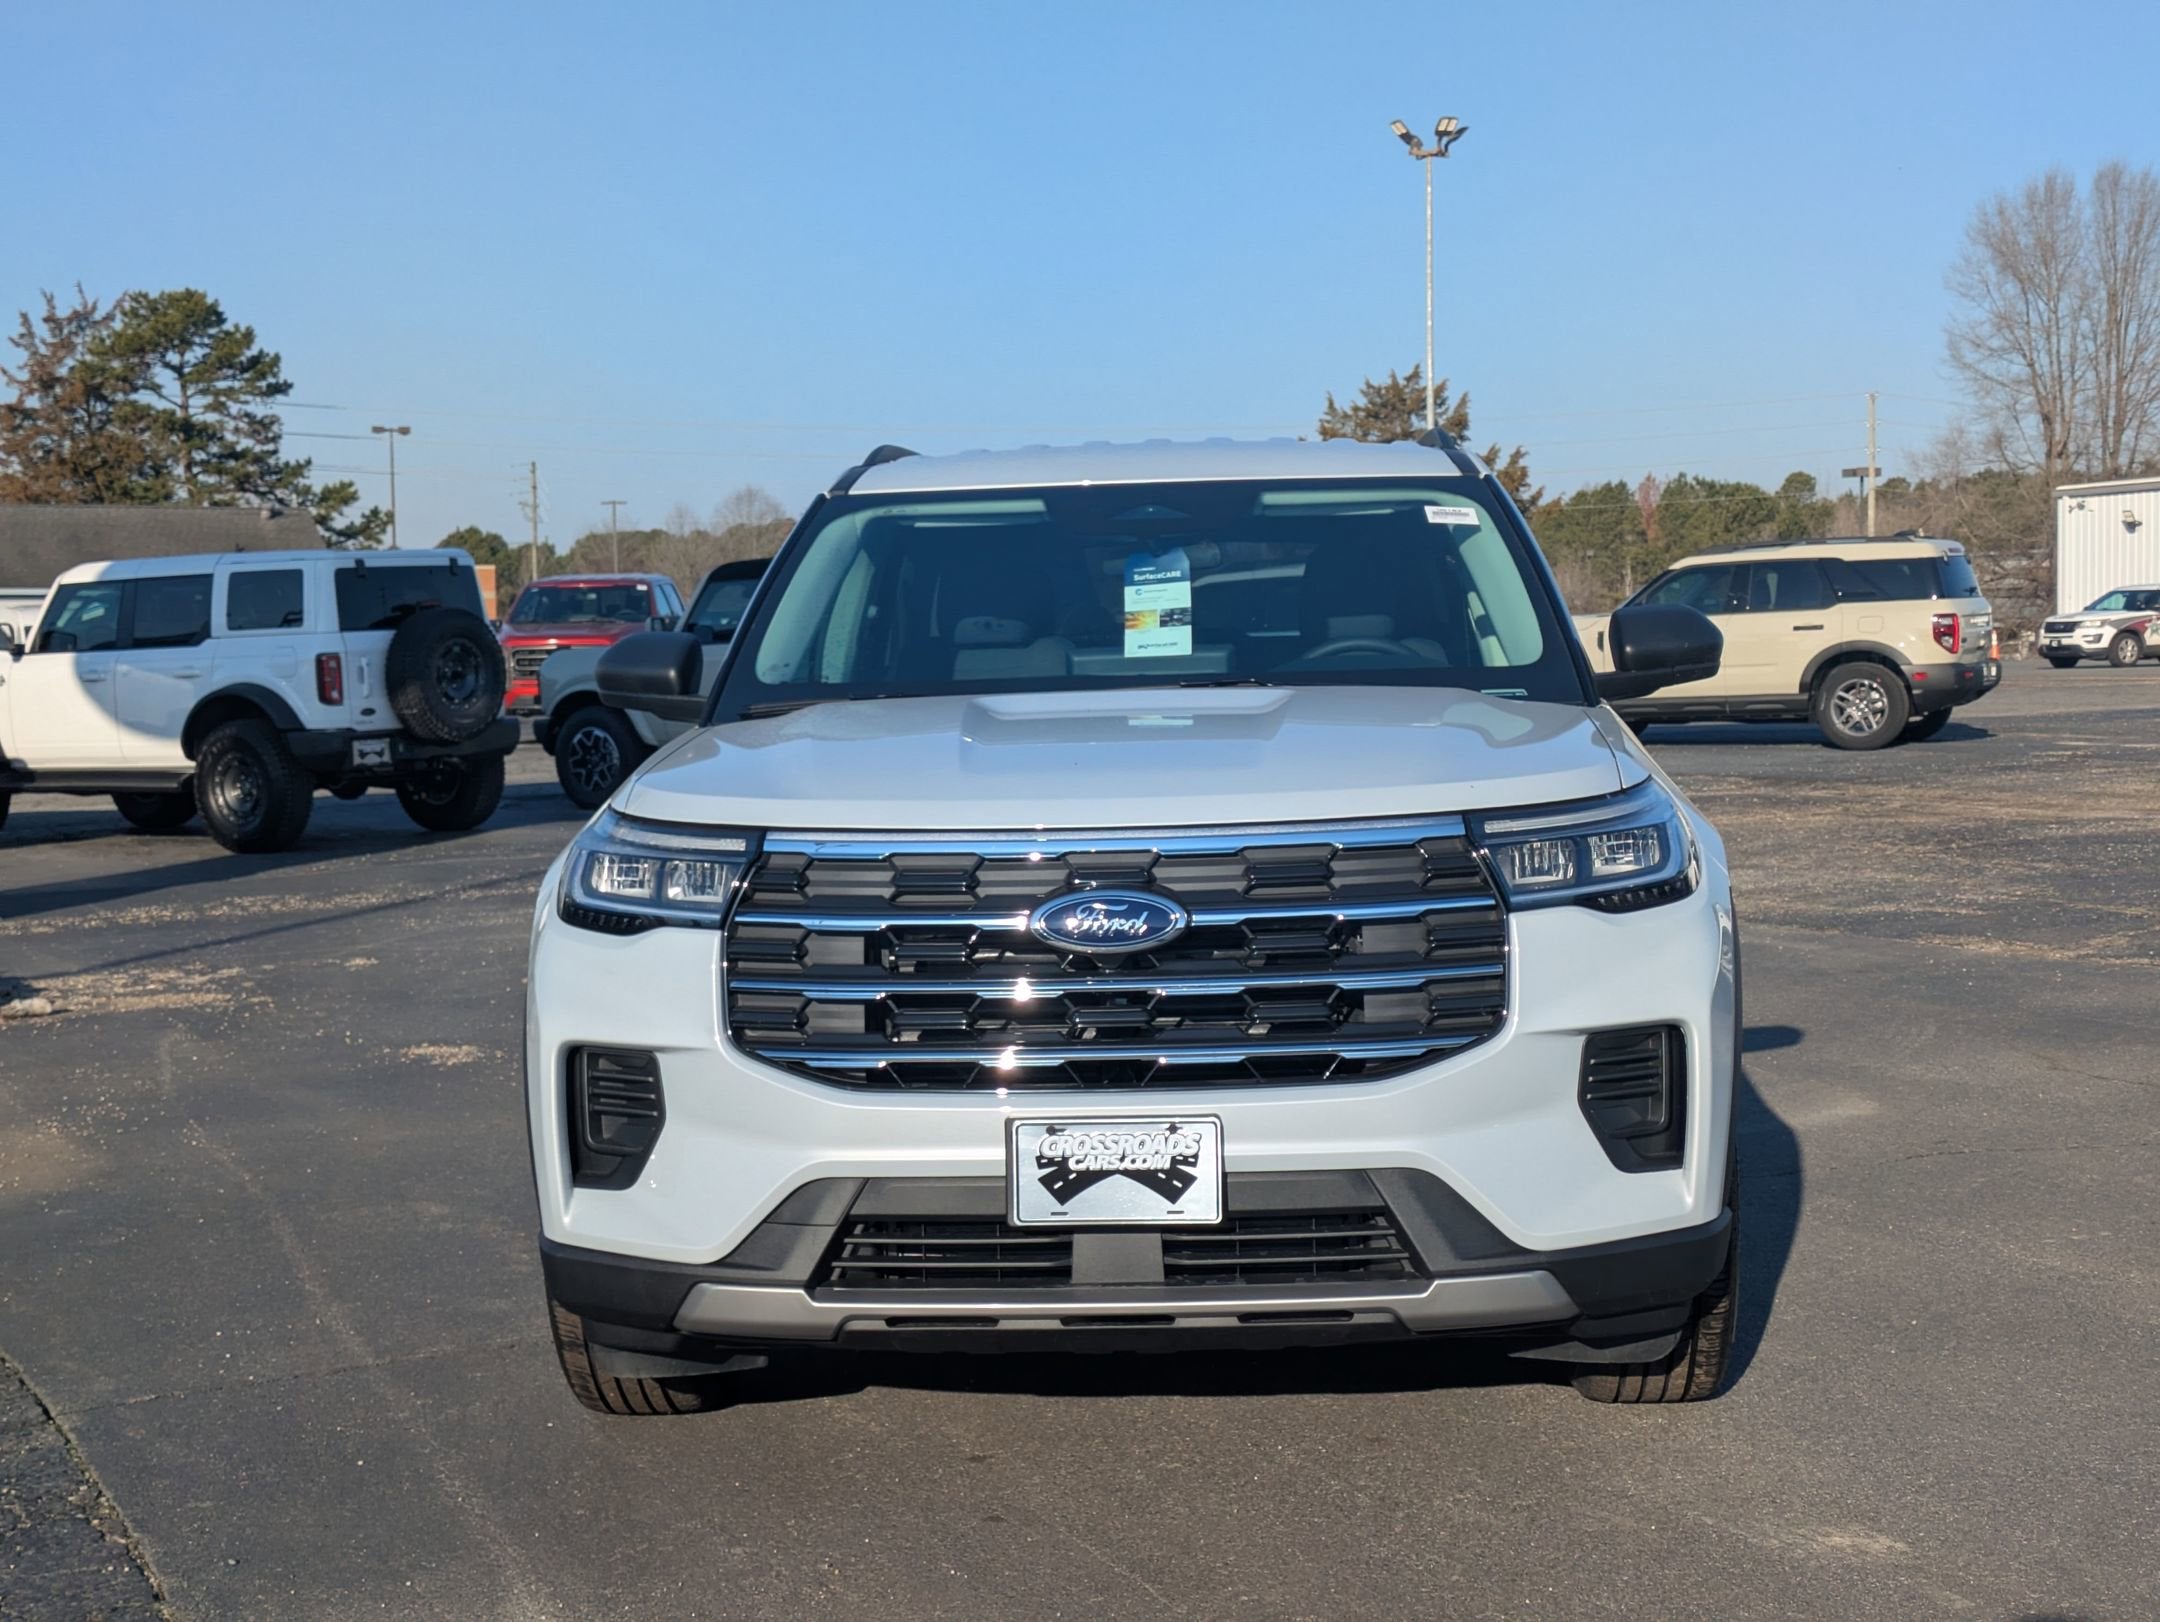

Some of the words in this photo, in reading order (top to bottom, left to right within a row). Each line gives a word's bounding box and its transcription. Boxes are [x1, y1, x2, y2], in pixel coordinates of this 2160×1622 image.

[1065, 903, 1149, 935] Ford
[1039, 1132, 1201, 1157] CROSSROADS
[1068, 1154, 1172, 1171] CARS.COM
